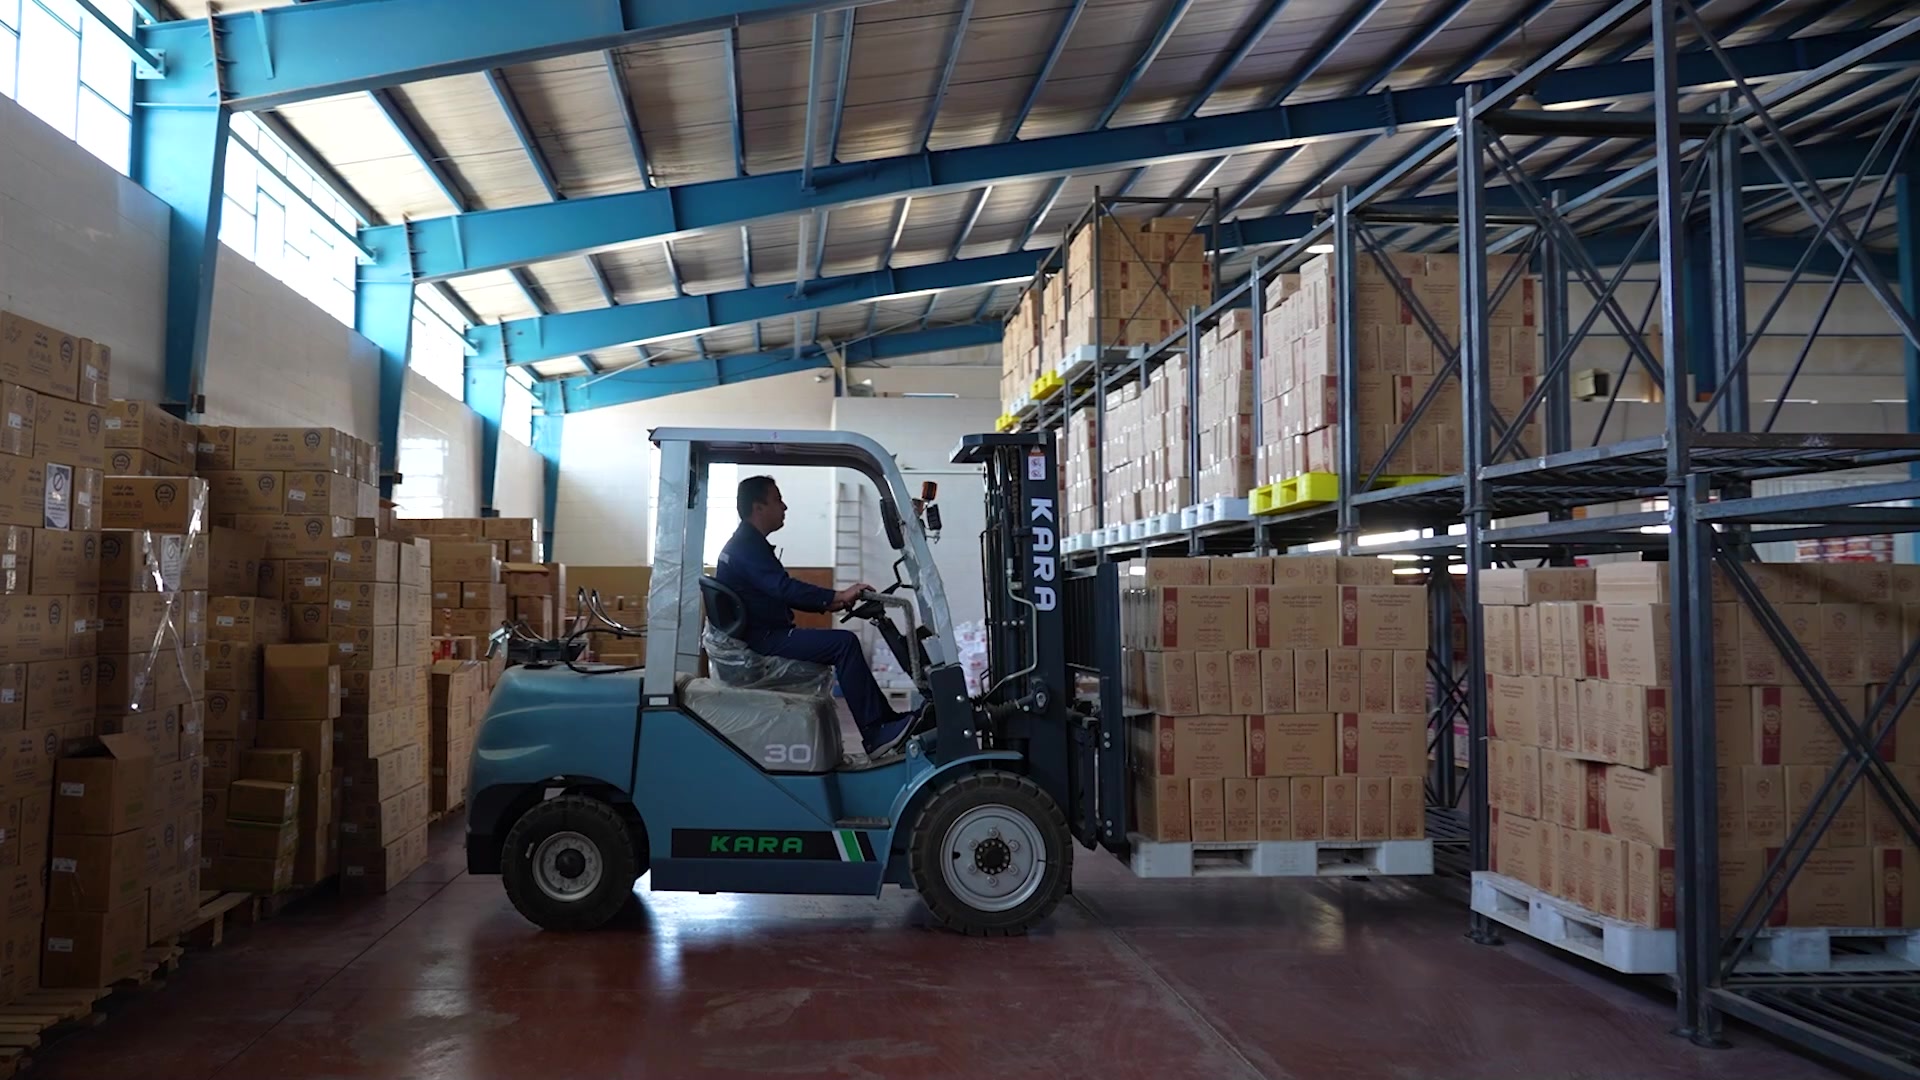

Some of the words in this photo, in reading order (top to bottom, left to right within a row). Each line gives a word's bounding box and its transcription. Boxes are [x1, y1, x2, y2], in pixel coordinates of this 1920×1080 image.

[1030, 497, 1057, 612] KARA
[763, 744, 812, 763] 30
[710, 835, 804, 853] KARA
